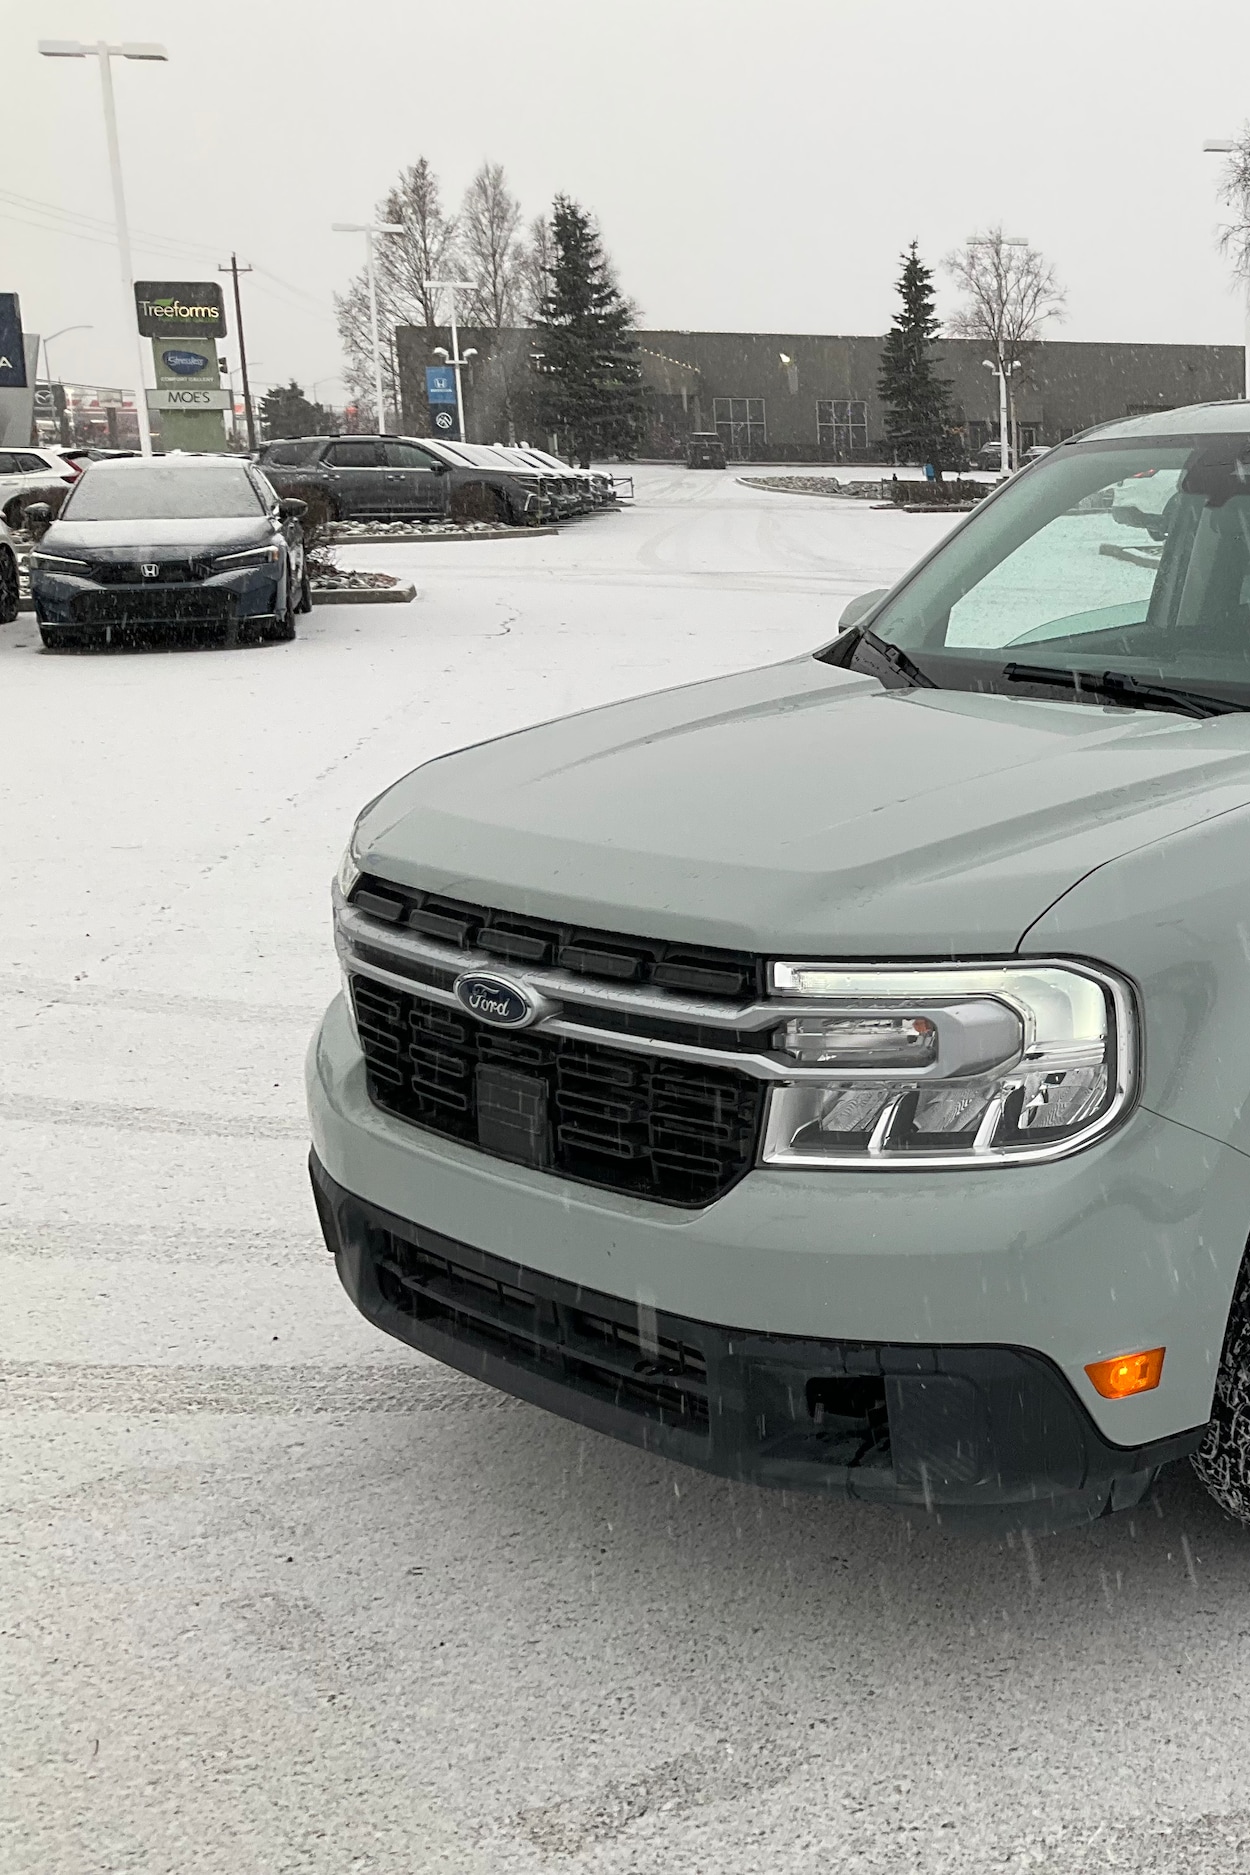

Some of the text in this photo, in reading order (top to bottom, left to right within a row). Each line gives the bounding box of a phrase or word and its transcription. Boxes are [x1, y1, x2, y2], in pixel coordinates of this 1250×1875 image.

[138, 300, 220, 318] Treeforms
[168, 391, 210, 403] MOE'S
[469, 984, 511, 1016] Ford
